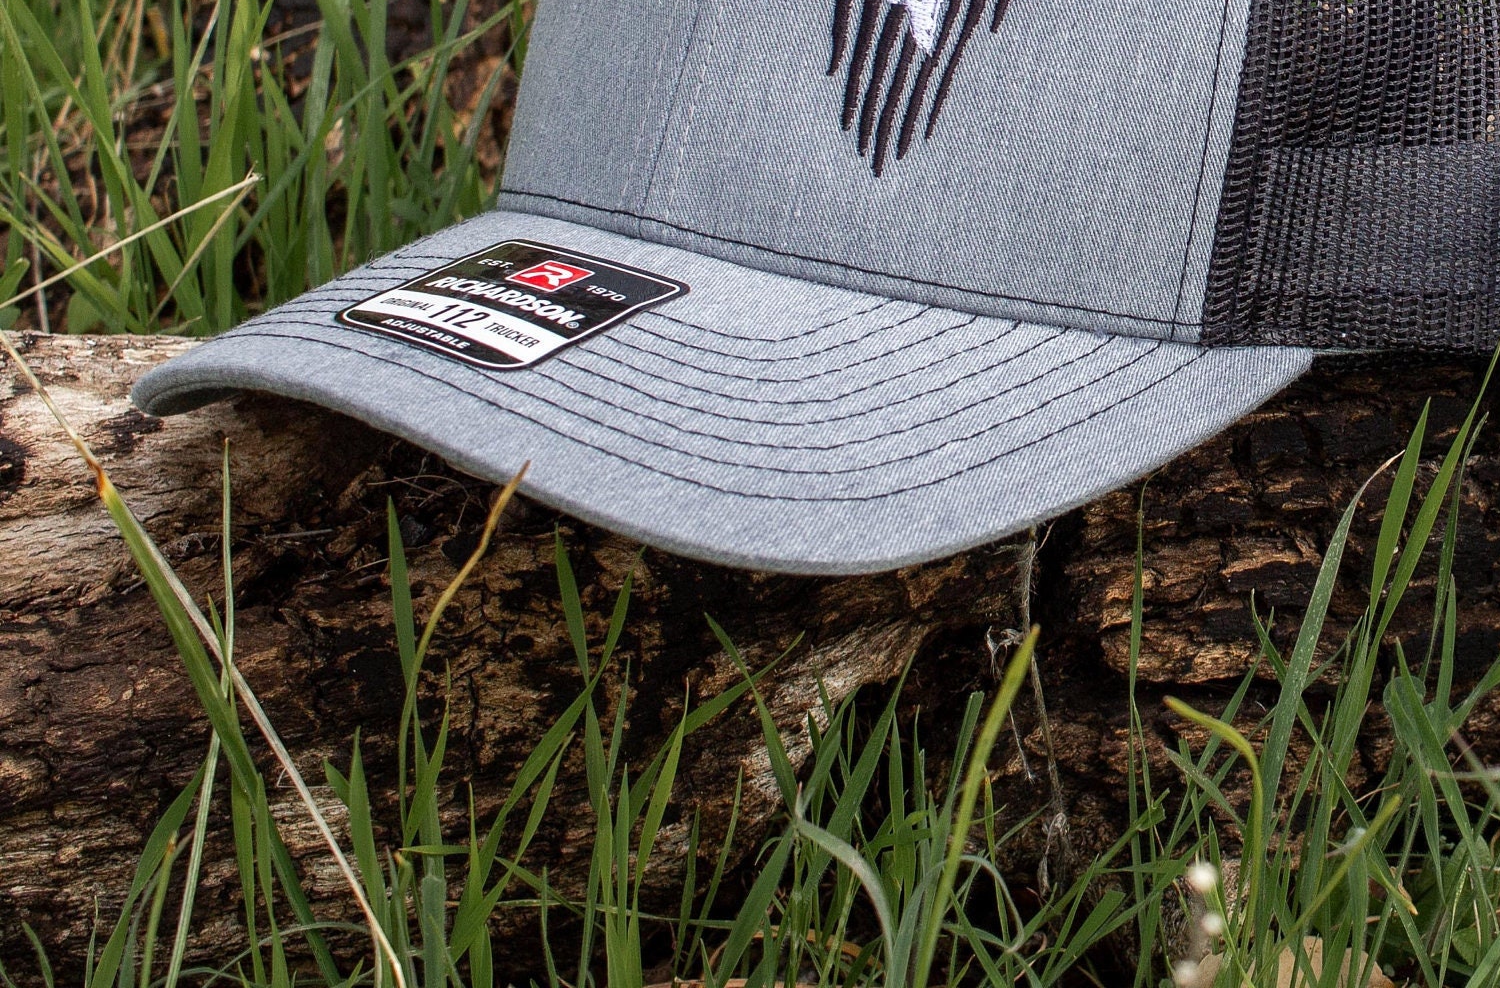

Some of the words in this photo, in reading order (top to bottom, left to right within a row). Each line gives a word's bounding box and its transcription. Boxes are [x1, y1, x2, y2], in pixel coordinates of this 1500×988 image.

[427, 276, 586, 328] RICHARDSON
[586, 283, 627, 302] 1970
[380, 297, 433, 312] ORIGINAL
[429, 303, 486, 330] 112
[483, 320, 540, 349] TRUCKER
[380, 317, 470, 350] ADJUSTABLE
